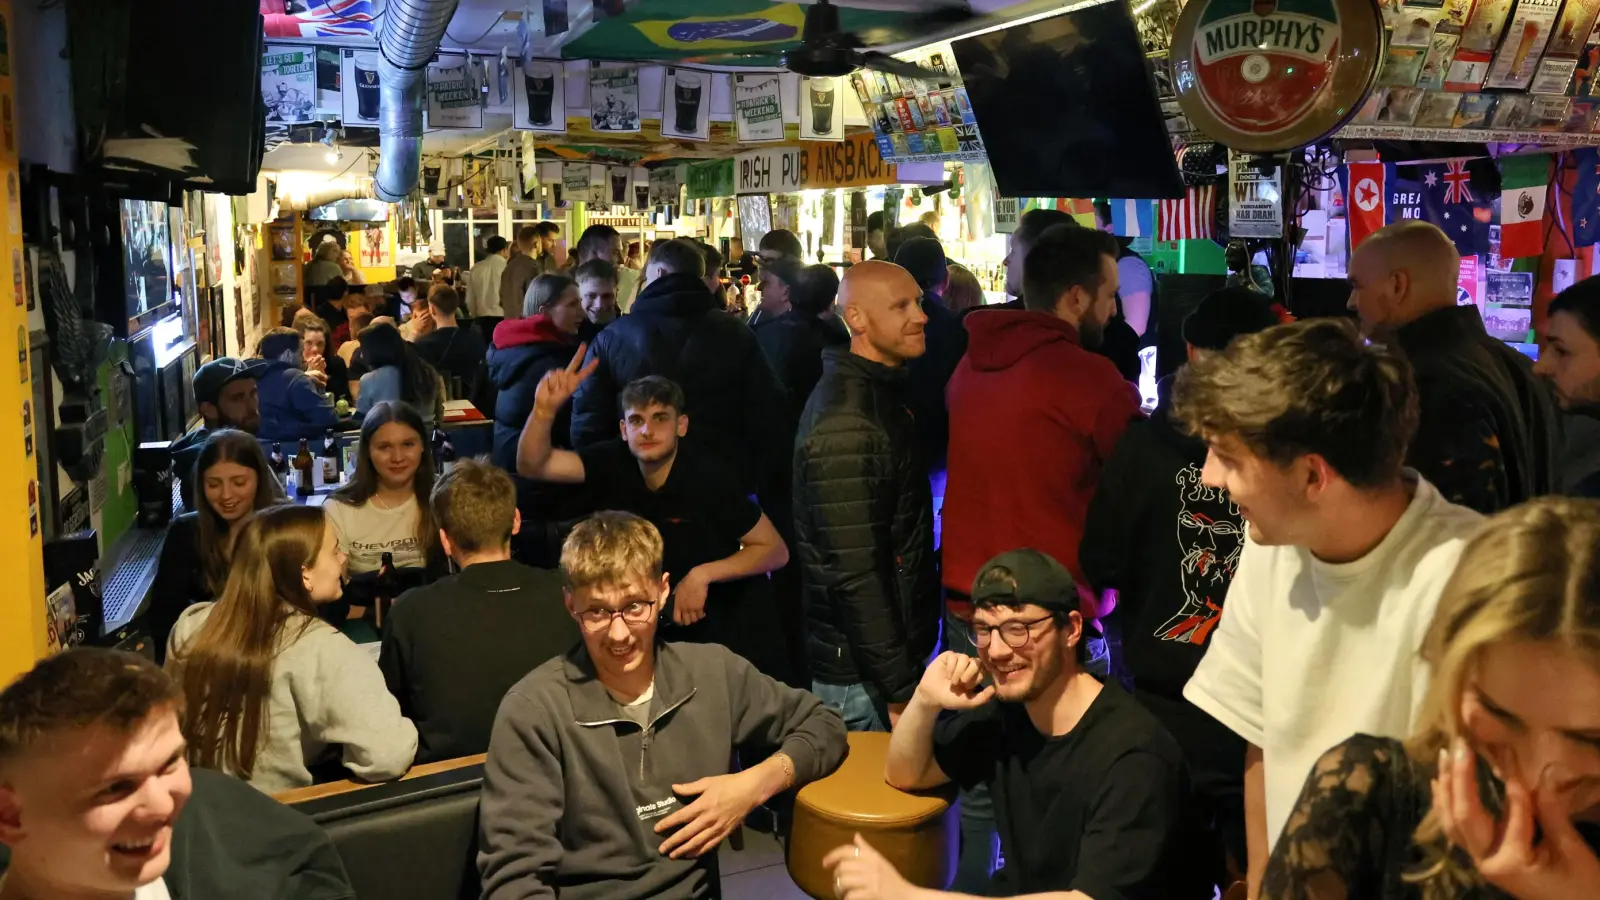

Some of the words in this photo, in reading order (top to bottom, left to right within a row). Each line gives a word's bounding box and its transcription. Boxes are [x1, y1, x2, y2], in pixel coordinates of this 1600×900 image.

[1204, 19, 1325, 56] MURPHY'S
[265, 56, 283, 65] LET'S
[283, 54, 294, 63] GET
[283, 63, 310, 74] TOGETHER
[745, 104, 775, 117] WEEKEND
[740, 155, 771, 189] IRISH
[783, 150, 809, 187] PUB
[816, 140, 891, 183] ANSBACH
[1002, 200, 1016, 214] YOU
[590, 217, 624, 227] EXPLICIT
[656, 796, 677, 808] Studio
